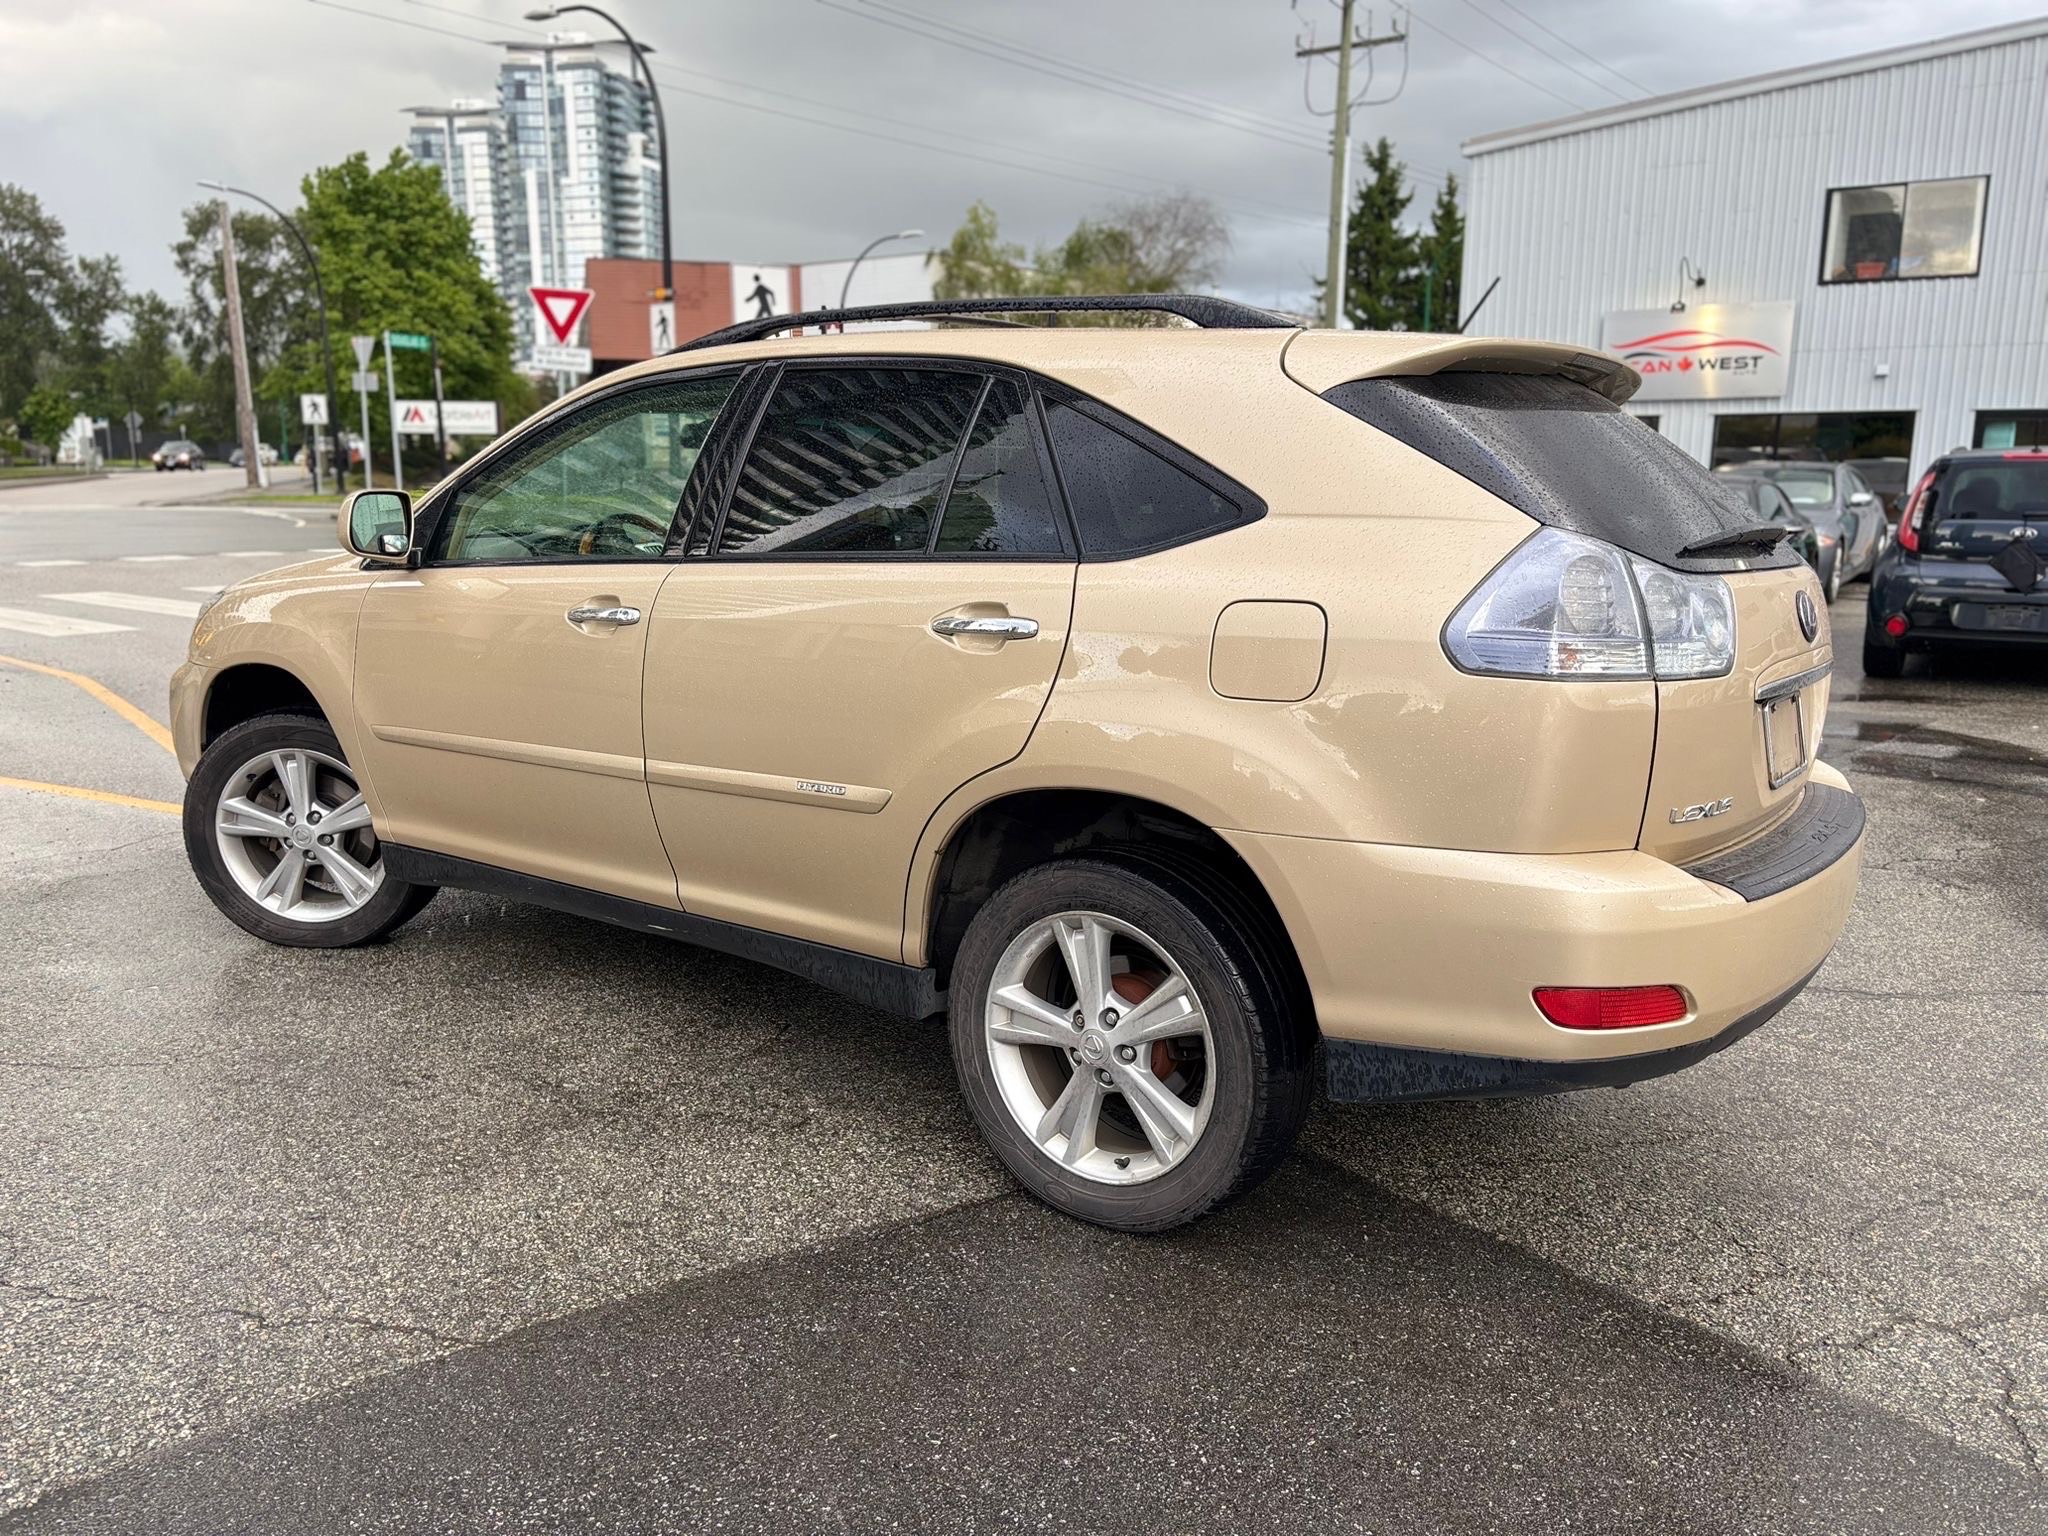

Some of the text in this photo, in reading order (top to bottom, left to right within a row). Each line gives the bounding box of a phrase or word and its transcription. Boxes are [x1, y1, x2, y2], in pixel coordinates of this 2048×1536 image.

[1698, 355, 1763, 371] WEST
[797, 781, 846, 795] HYBRID
[1669, 797, 1734, 824] LEXUS
